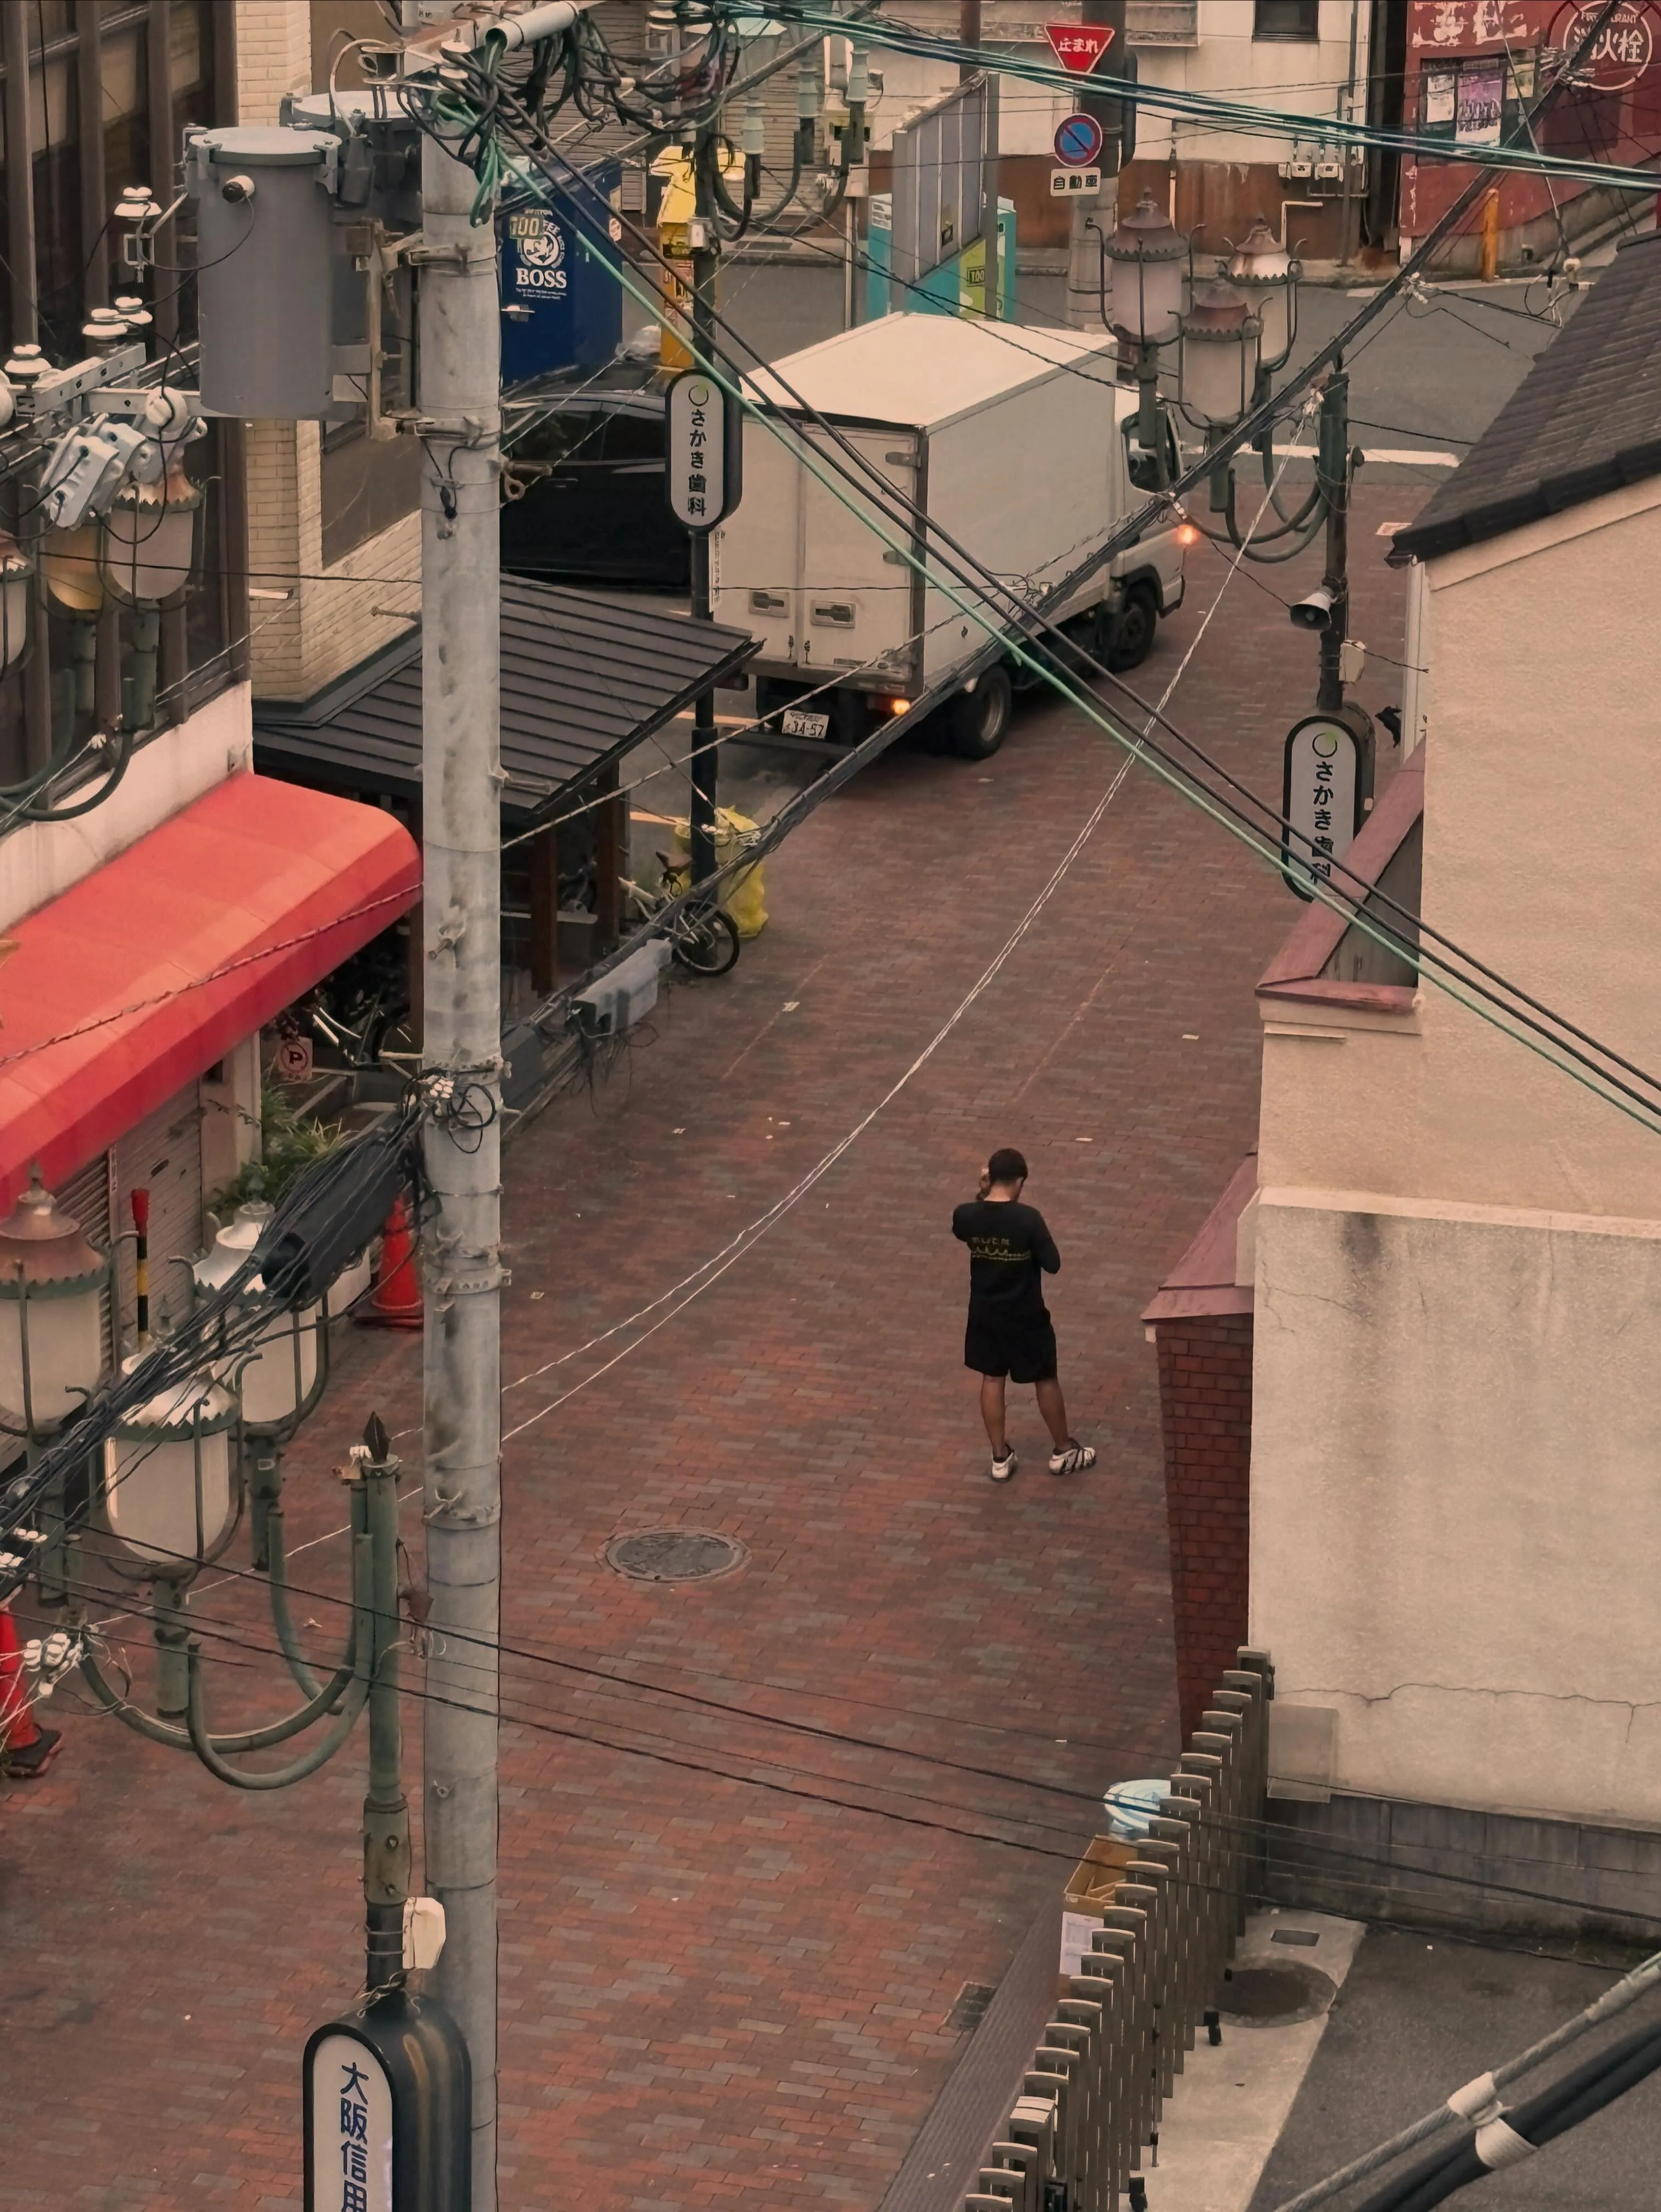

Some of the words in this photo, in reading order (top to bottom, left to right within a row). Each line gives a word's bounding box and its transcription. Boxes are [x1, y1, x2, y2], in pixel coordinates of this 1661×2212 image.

[1057, 37, 1099, 54] 止まれ
[510, 216, 539, 236] 100
[516, 267, 567, 288] BOSS
[688, 409, 707, 517] さかき歯科
[339, 2061, 370, 2212] 大阪信用
